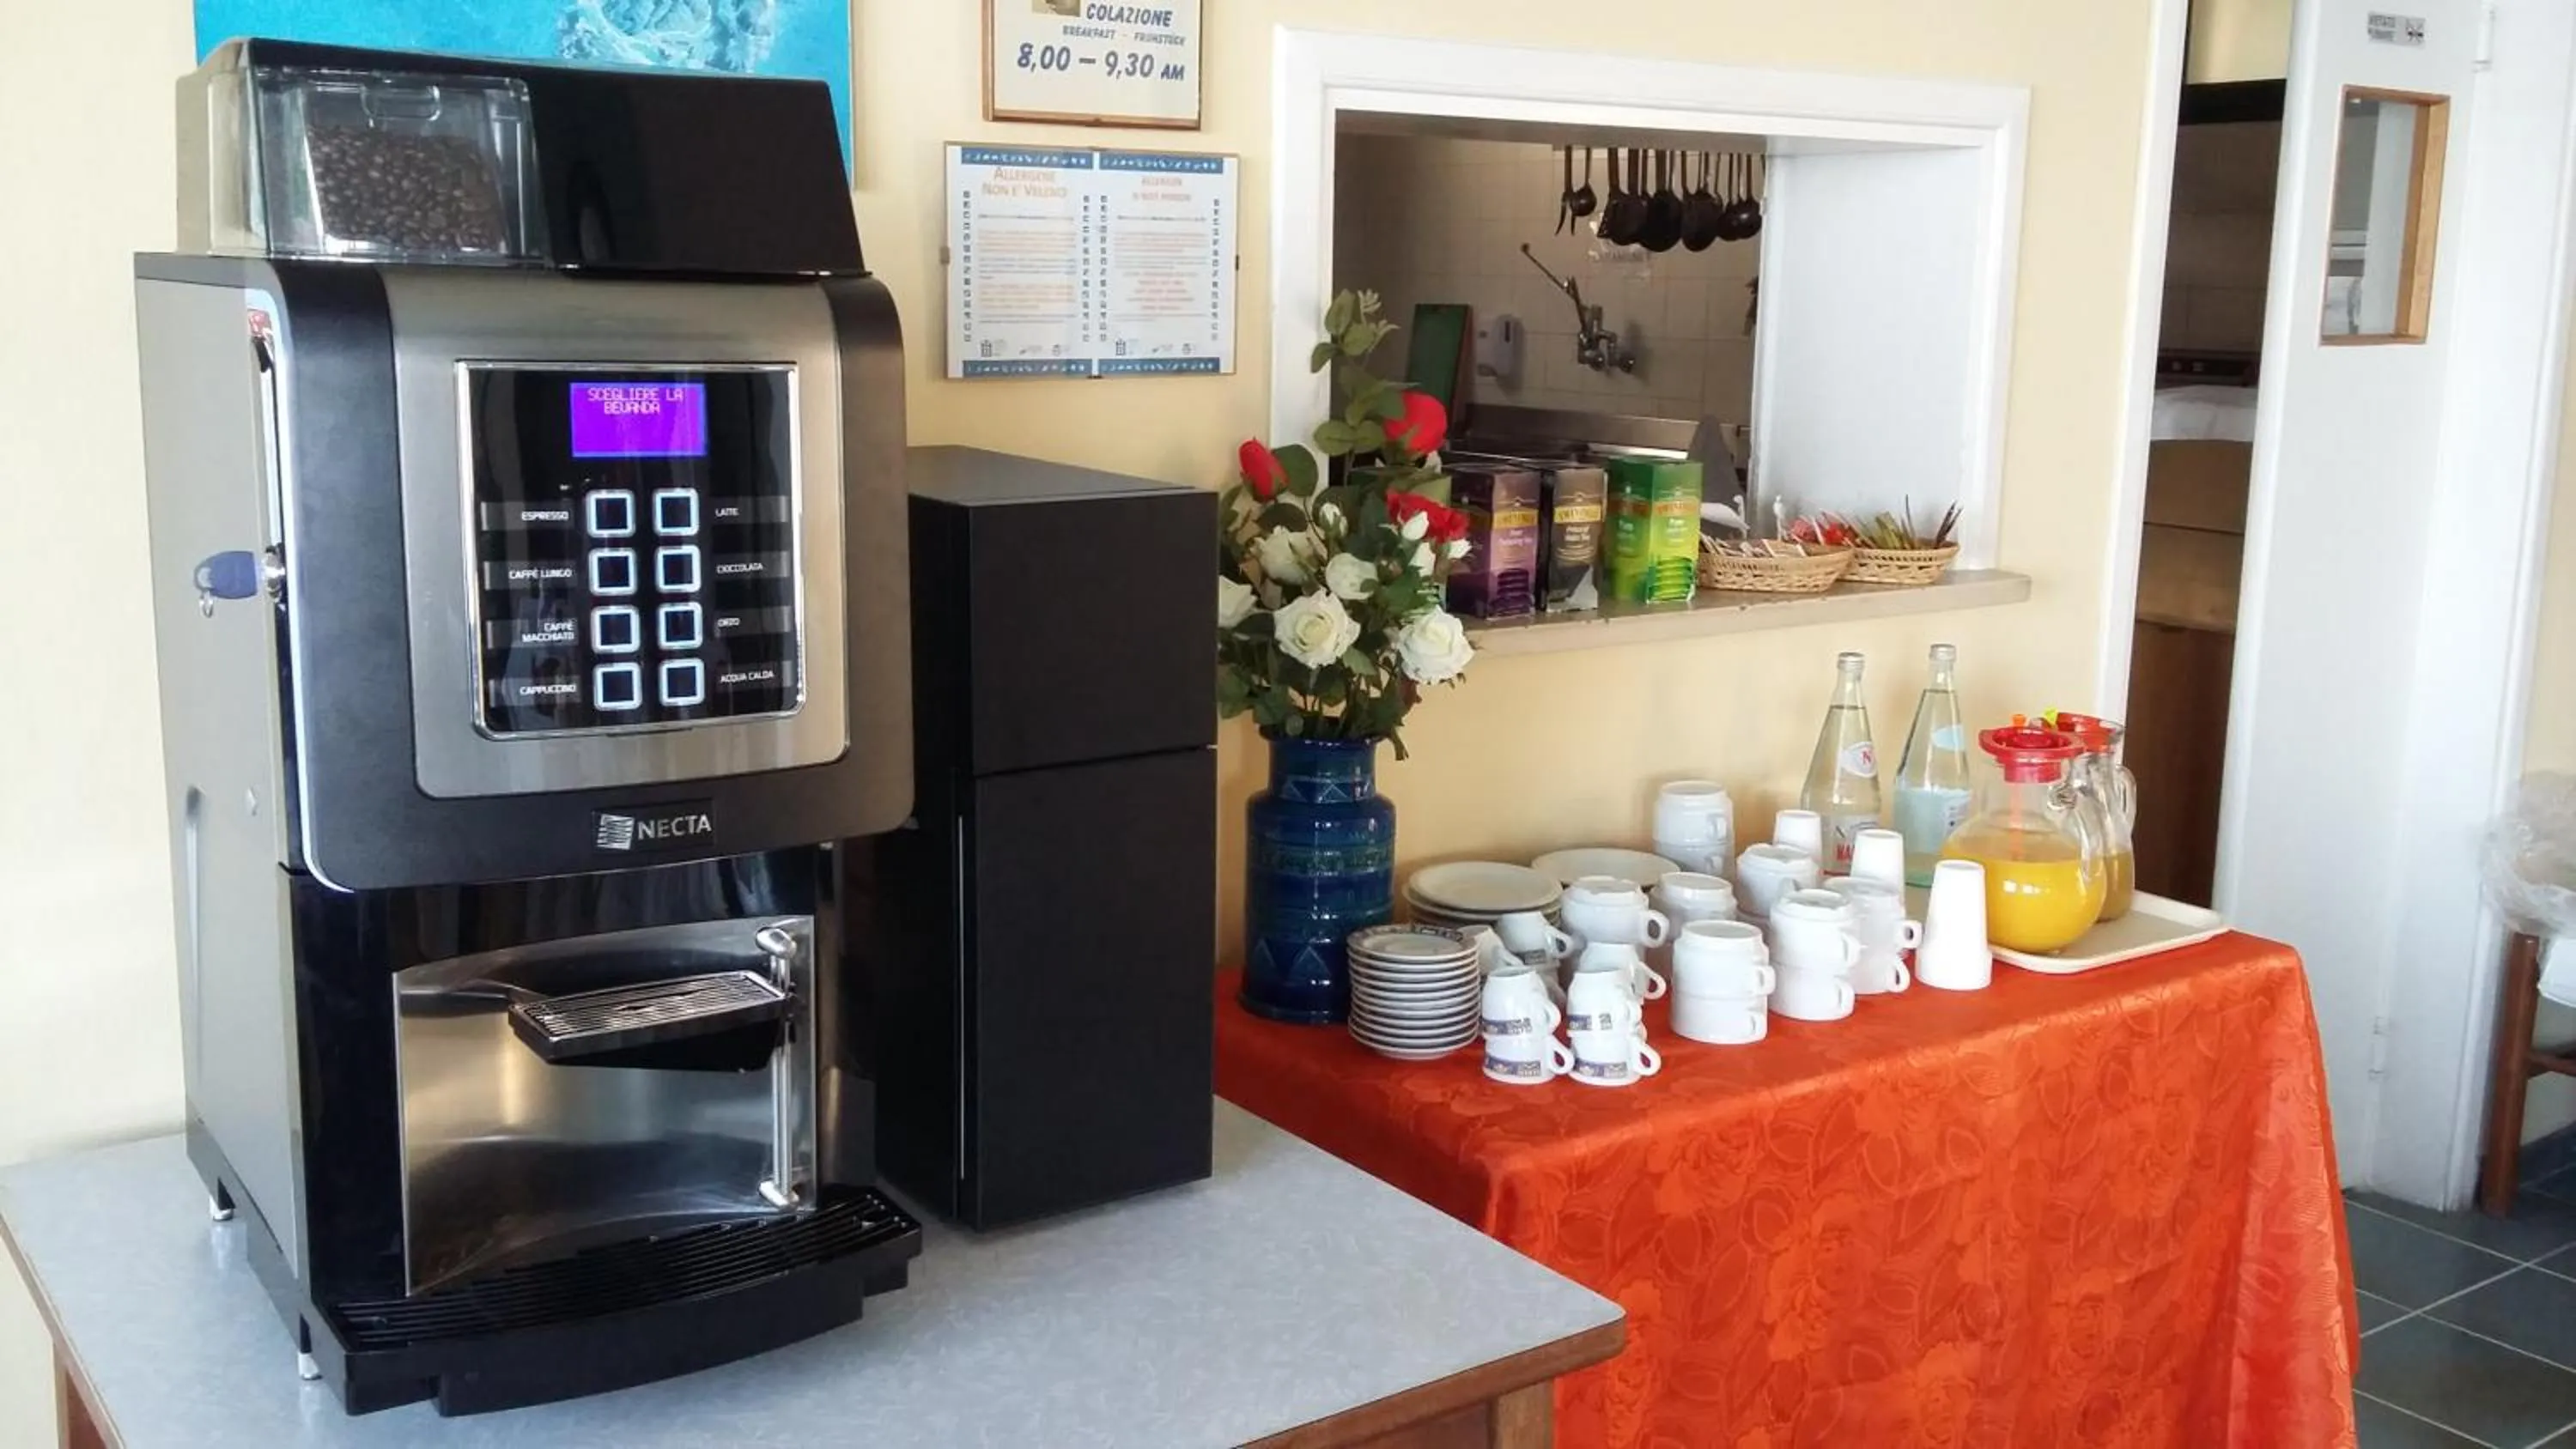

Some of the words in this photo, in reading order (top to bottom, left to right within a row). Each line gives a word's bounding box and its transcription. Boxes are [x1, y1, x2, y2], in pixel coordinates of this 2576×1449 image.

[1086, 3, 1173, 27] COLAZIONE
[1017, 42, 1071, 72] 8,00
[1104, 51, 1155, 80] 9,30
[1160, 63, 1186, 81] AM
[587, 387, 659, 401] SCEGLIERE
[666, 387, 683, 402] LA
[604, 400, 660, 415] BEVANDA
[521, 511, 569, 521] ESPRESSO
[714, 507, 739, 517] LATTE
[540, 568, 573, 578] LUNGO
[716, 562, 763, 574] CIOCCOLATA
[522, 631, 574, 643] MACCHIATO
[720, 673, 747, 683] ACQUA
[748, 670, 775, 681] CALDA
[519, 684, 576, 695] CAPPUCCINO
[638, 814, 712, 840] NECTA
